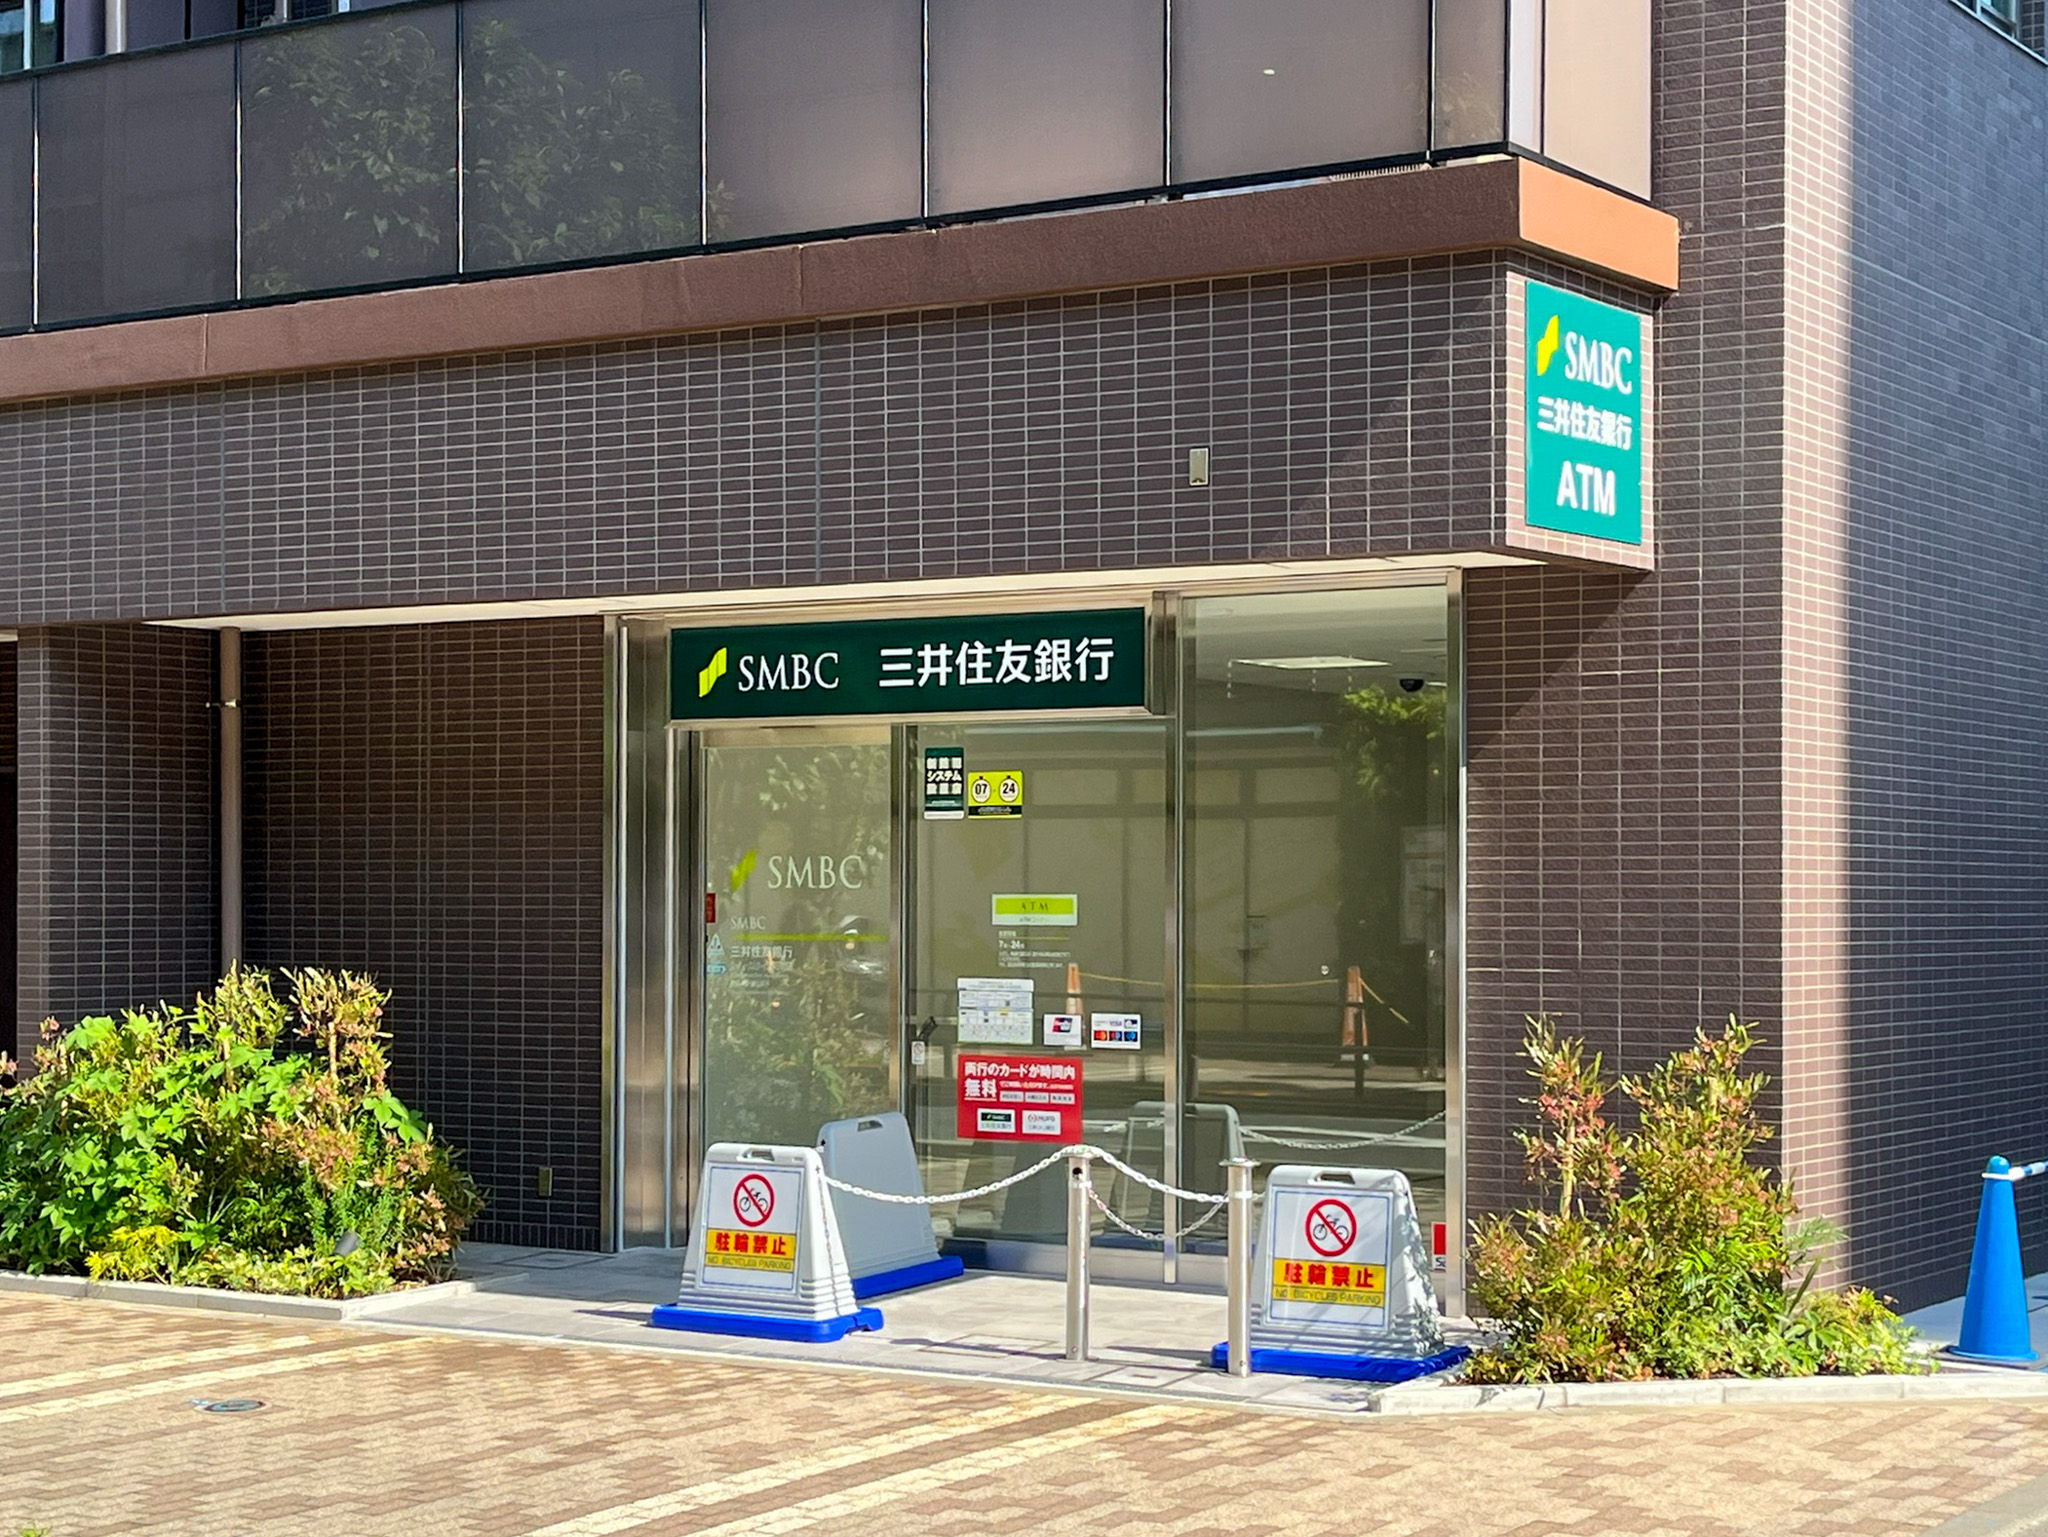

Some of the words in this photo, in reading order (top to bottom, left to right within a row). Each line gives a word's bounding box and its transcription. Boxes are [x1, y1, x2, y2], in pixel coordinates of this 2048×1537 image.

[1564, 330, 1633, 395] SMBC
[1537, 396, 1633, 450] 三井住友銀行
[1556, 460, 1617, 516] ATM
[738, 651, 840, 693] SMBC
[878, 637, 1115, 689] 三井住友銀行
[975, 783, 988, 795] 07
[1002, 783, 1016, 794] 24
[767, 854, 864, 890] SMBC
[730, 915, 767, 930] SMBC
[964, 1078, 998, 1098] 無料
[714, 1231, 787, 1256] 駐輪禁止
[707, 1256, 719, 1265] NO
[758, 1259, 792, 1271] PARKING
[1283, 1262, 1374, 1288] 駐輪禁止
[1275, 1289, 1288, 1298] NO
[1339, 1291, 1381, 1305] PARKING
